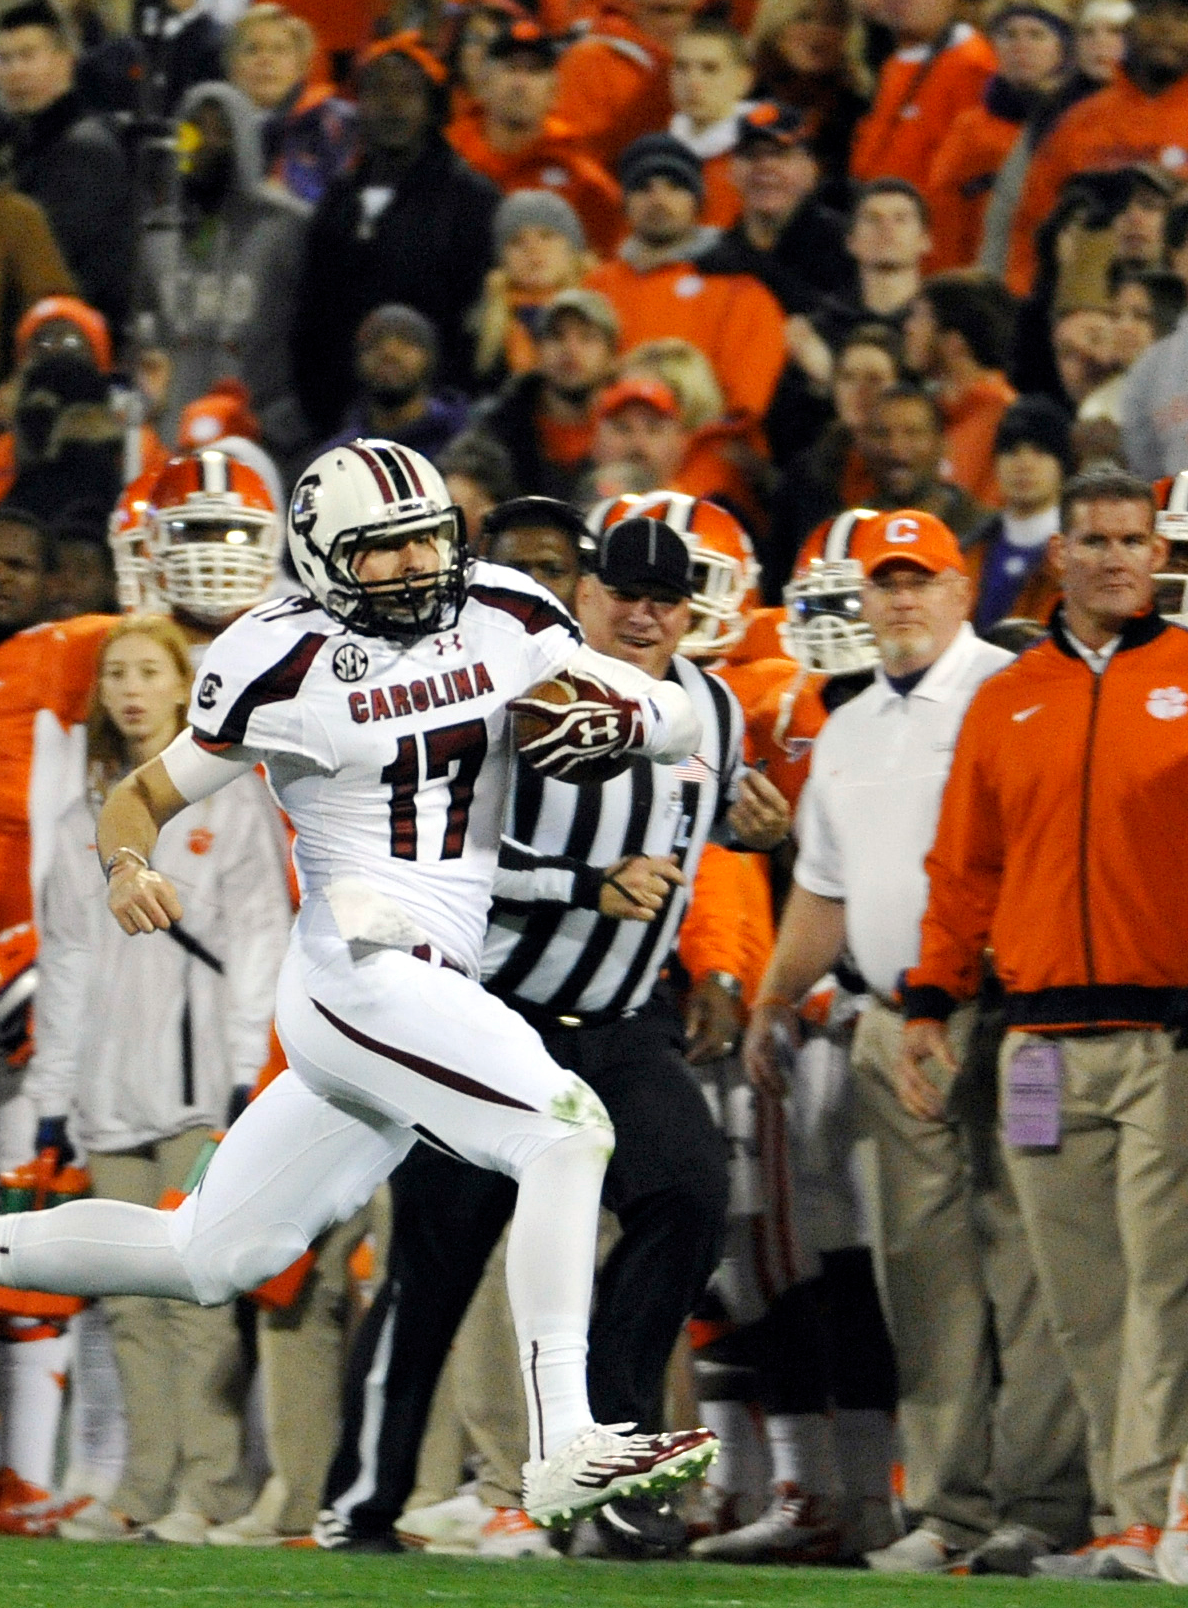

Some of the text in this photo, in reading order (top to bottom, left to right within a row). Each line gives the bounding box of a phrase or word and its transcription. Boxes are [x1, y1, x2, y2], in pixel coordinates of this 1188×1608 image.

[885, 517, 920, 544] C
[333, 643, 369, 682] SEC
[347, 661, 496, 725] CAROLINA
[380, 717, 489, 862] 17
